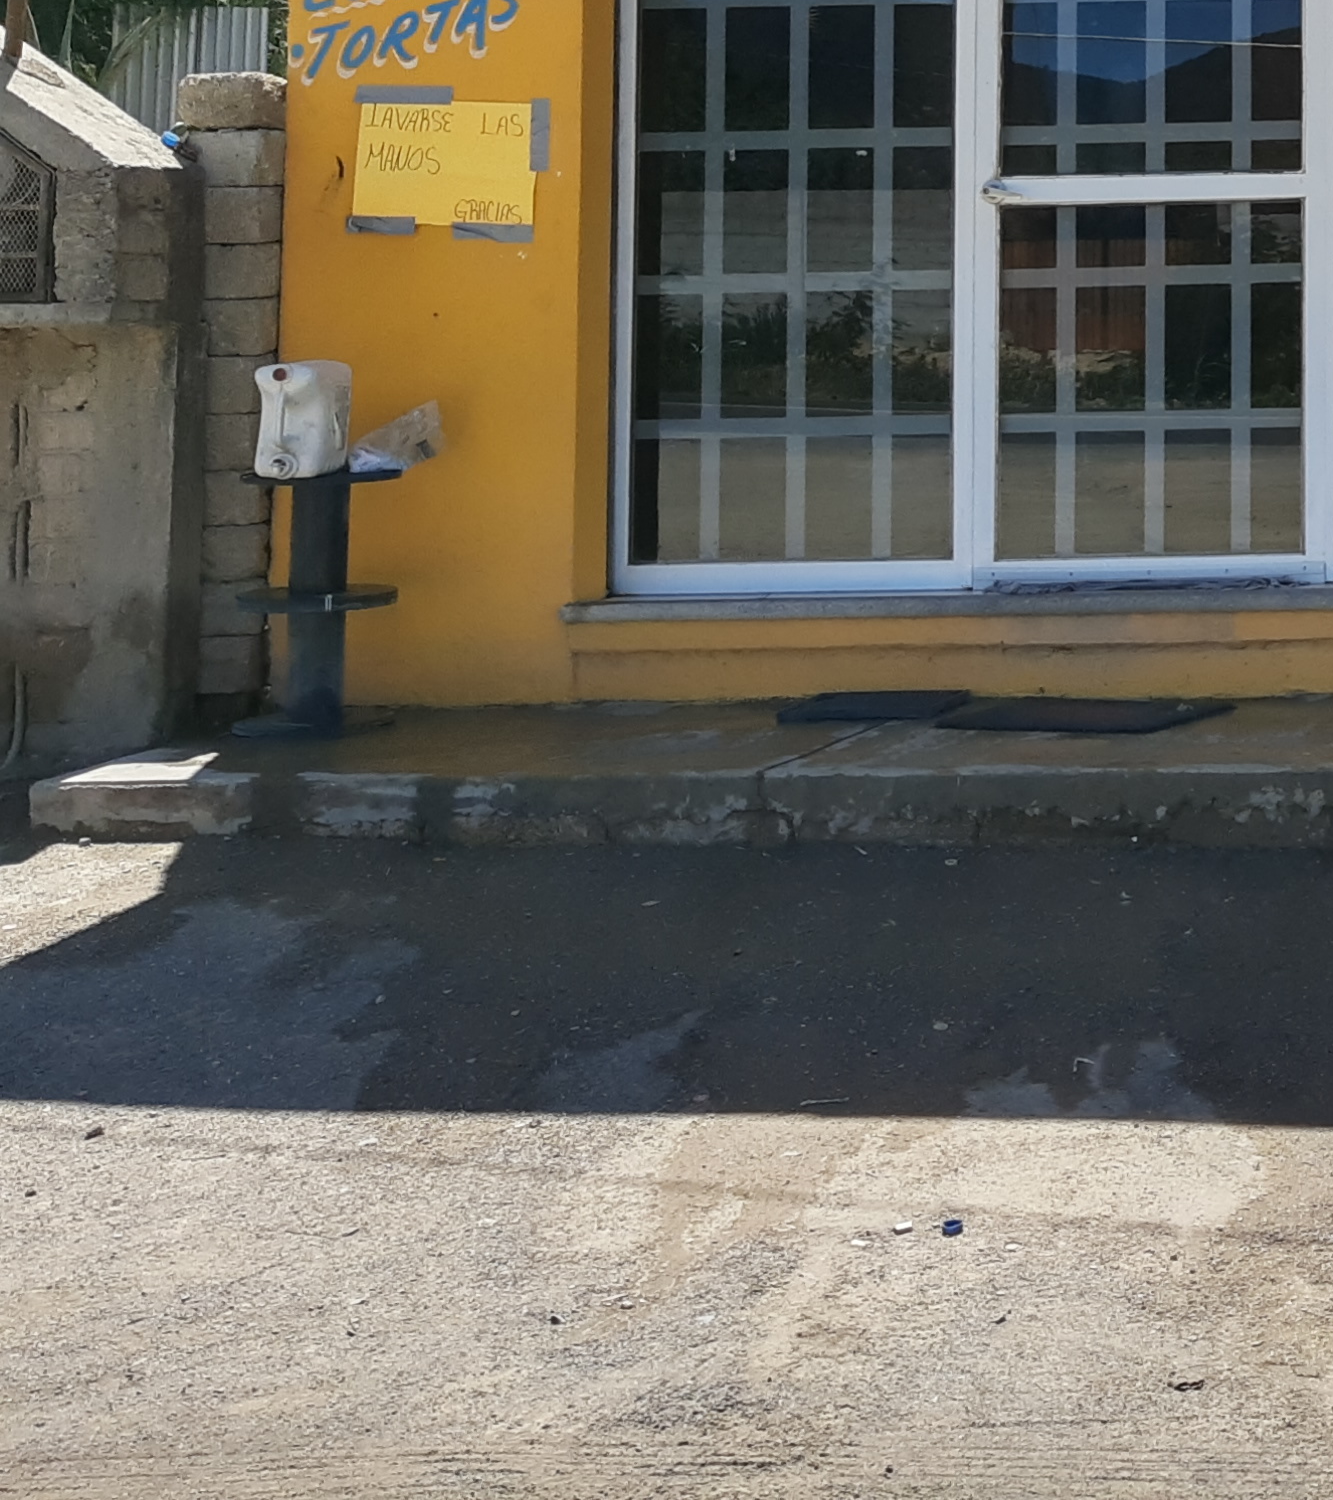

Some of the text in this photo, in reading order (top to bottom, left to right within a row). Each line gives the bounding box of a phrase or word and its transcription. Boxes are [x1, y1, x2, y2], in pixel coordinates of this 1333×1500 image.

[480, 112, 524, 137] LAS
[364, 141, 441, 175] MANOS
[454, 199, 522, 224] GRACIAS
